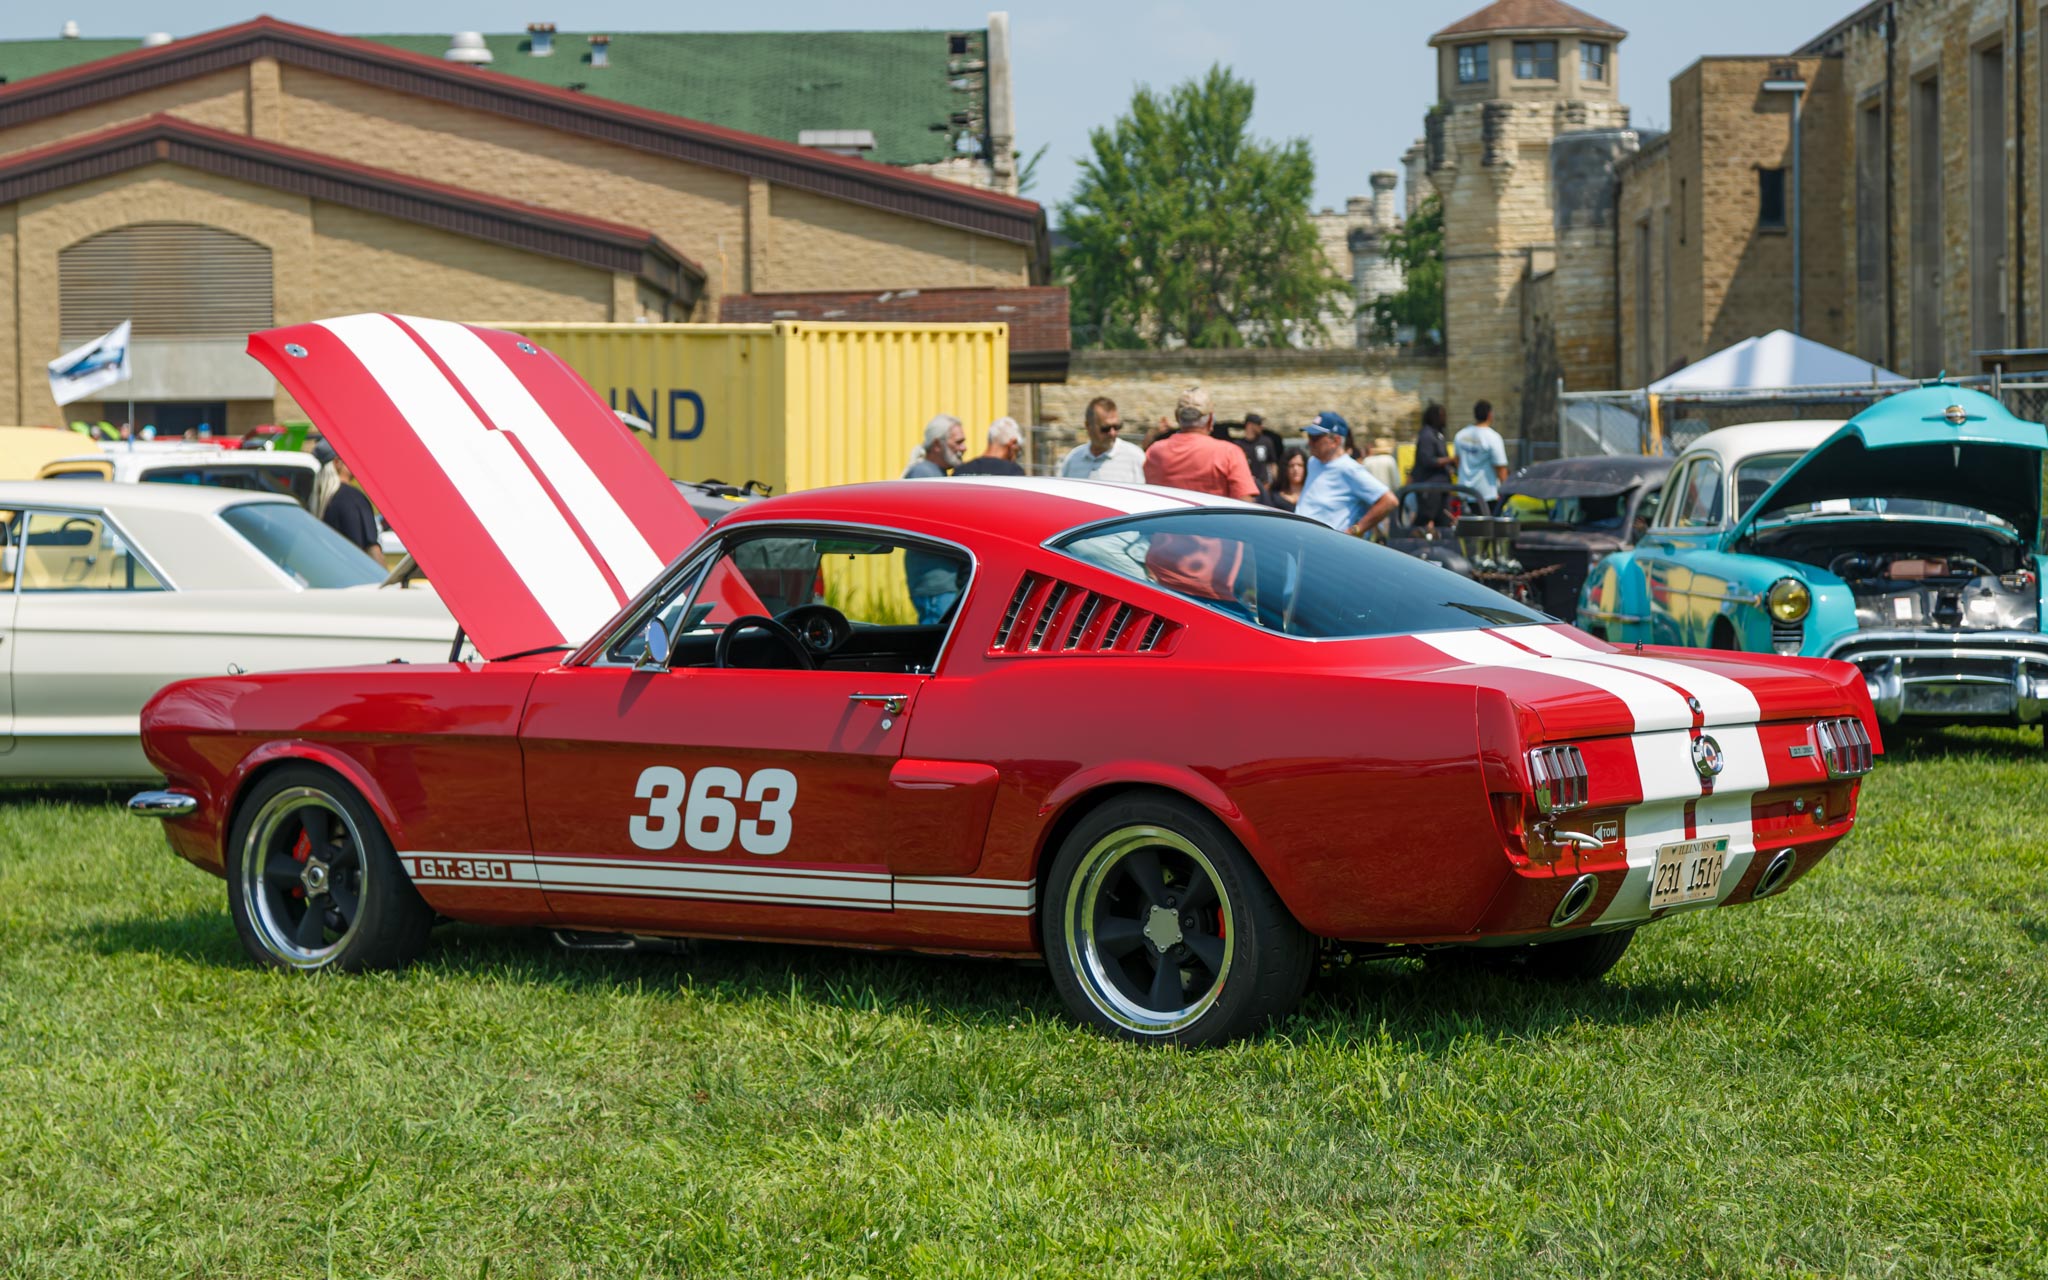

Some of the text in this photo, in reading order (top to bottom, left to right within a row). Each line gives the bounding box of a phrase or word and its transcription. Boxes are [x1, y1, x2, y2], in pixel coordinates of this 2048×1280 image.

[629, 765, 798, 855] 363
[1603, 827, 1616, 837] TOW
[1679, 841, 1710, 855] ILLINOIS
[420, 859, 507, 880] G.T.350
[1655, 861, 1682, 896] 231
[1687, 856, 1713, 891] 151
